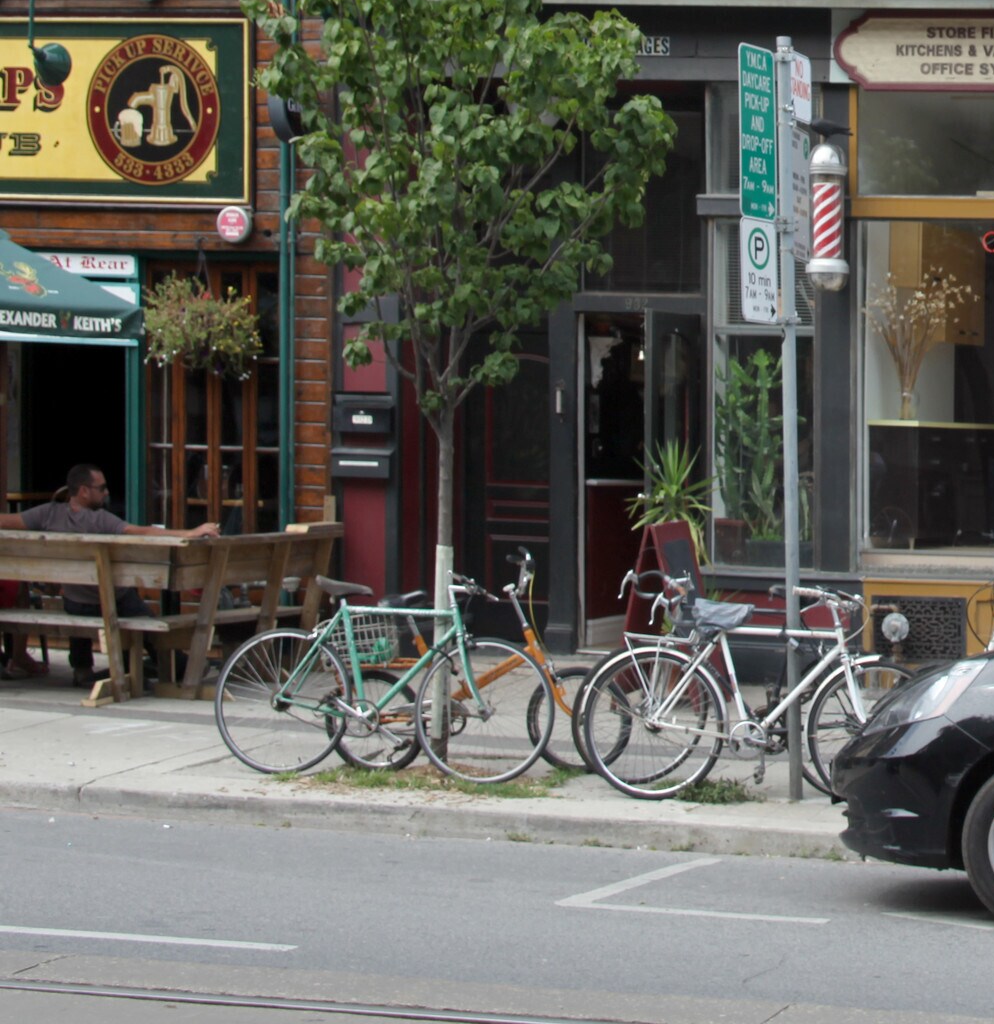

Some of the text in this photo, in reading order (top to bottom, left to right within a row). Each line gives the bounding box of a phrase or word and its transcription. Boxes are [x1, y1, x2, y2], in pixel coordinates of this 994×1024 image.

[926, 27, 976, 39] STORE
[896, 44, 963, 57] KITCHENS
[968, 44, 977, 57] &
[94, 50, 125, 94] PICK
[125, 39, 147, 58] UP
[746, 50, 767, 72] YMCA
[920, 63, 974, 76] OFFICE
[742, 71, 771, 93] DAYCARE
[744, 92, 769, 113] PICK-UP
[750, 115, 765, 133] AND
[741, 134, 774, 155] DROP-OFF
[749, 156, 767, 175] AREA
[743, 176, 755, 191] 7AM
[761, 180, 774, 194] 9AM
[754, 236, 764, 260] P
[80, 256, 128, 270] Rear
[748, 272, 771, 287] 10 min
[745, 286, 757, 299] 7AM
[764, 288, 775, 301] 9AM
[73, 315, 122, 332] KEITH'S
